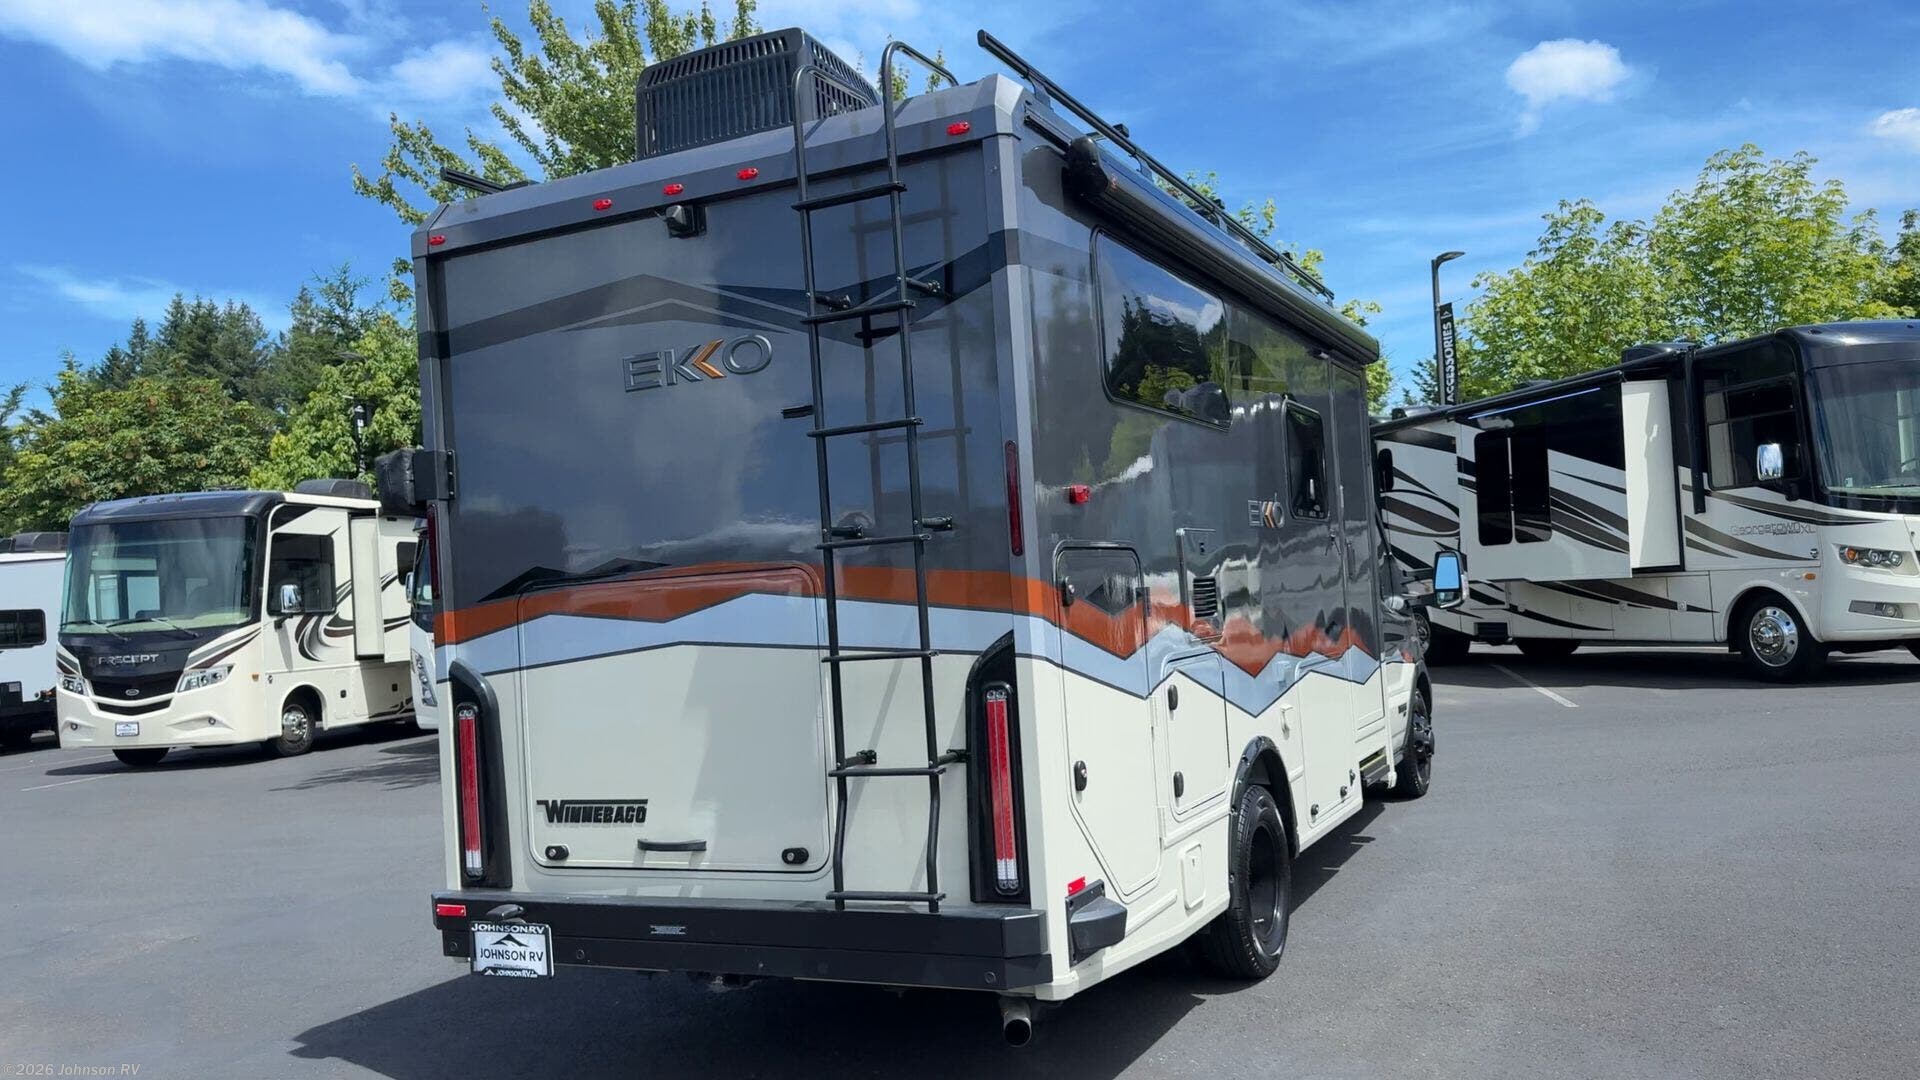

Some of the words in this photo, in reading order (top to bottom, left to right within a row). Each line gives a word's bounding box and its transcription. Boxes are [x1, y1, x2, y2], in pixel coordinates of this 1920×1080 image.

[1442, 321, 1455, 402] ACCESSORIES
[98, 653, 160, 665] PRECEPT
[480, 947, 527, 961] JOHNSON
[529, 951, 544, 962] RV
